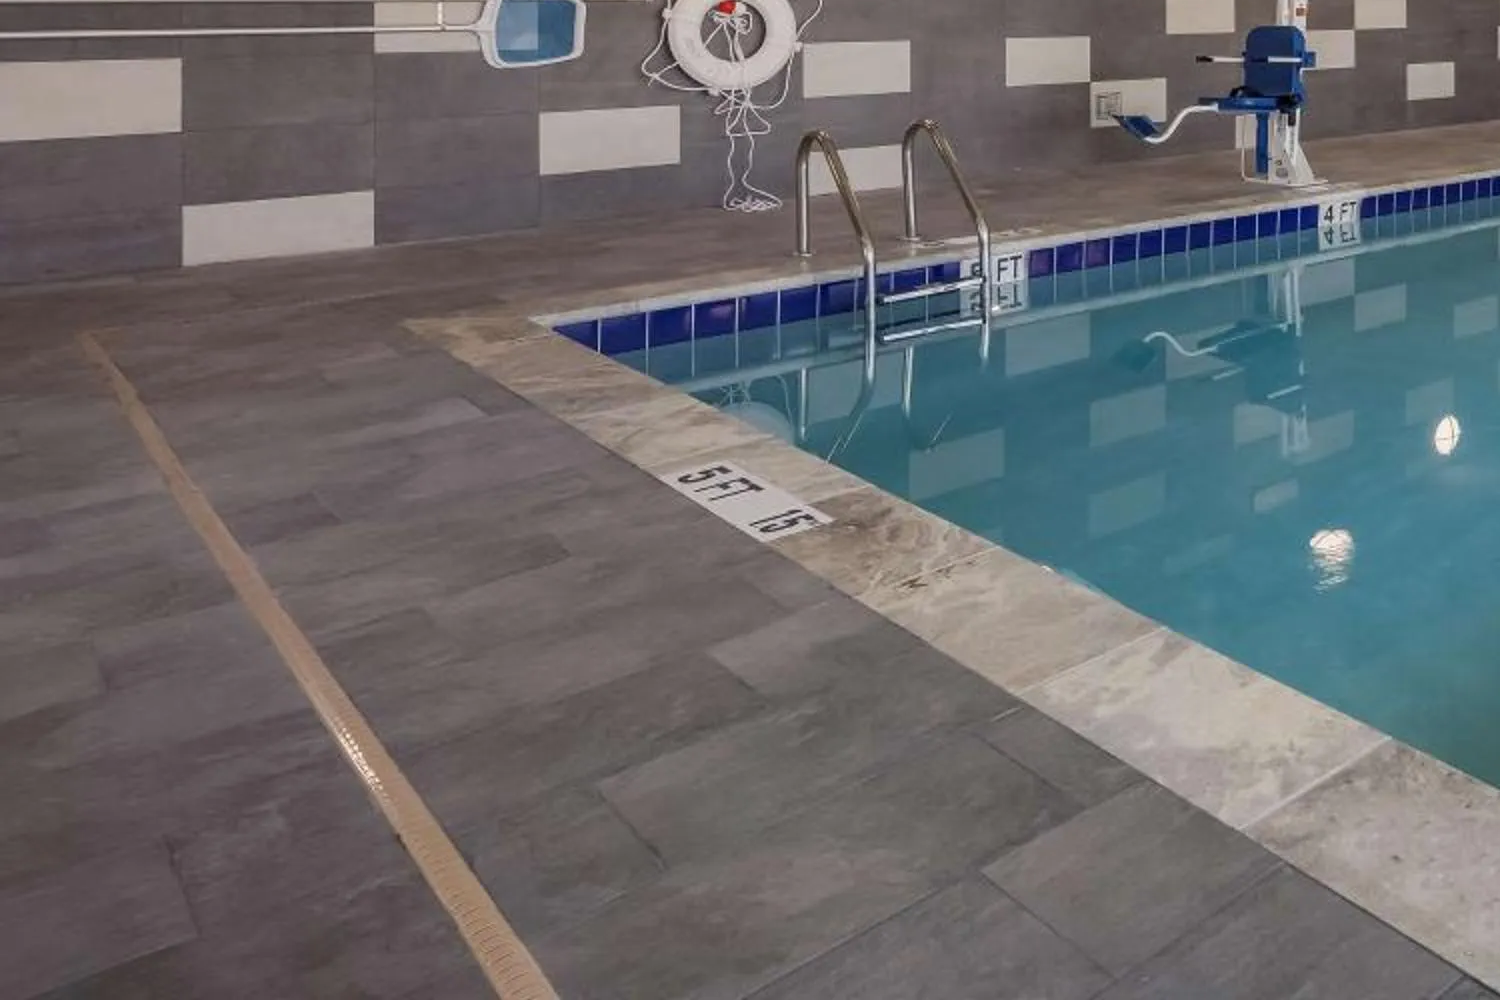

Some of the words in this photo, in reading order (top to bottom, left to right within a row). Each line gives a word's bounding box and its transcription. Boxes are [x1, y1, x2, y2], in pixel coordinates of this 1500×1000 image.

[1324, 205, 1334, 223] 4
[1340, 201, 1357, 222] FT
[997, 254, 1022, 282] FT
[677, 465, 733, 484] 5
[694, 477, 765, 501] FT
